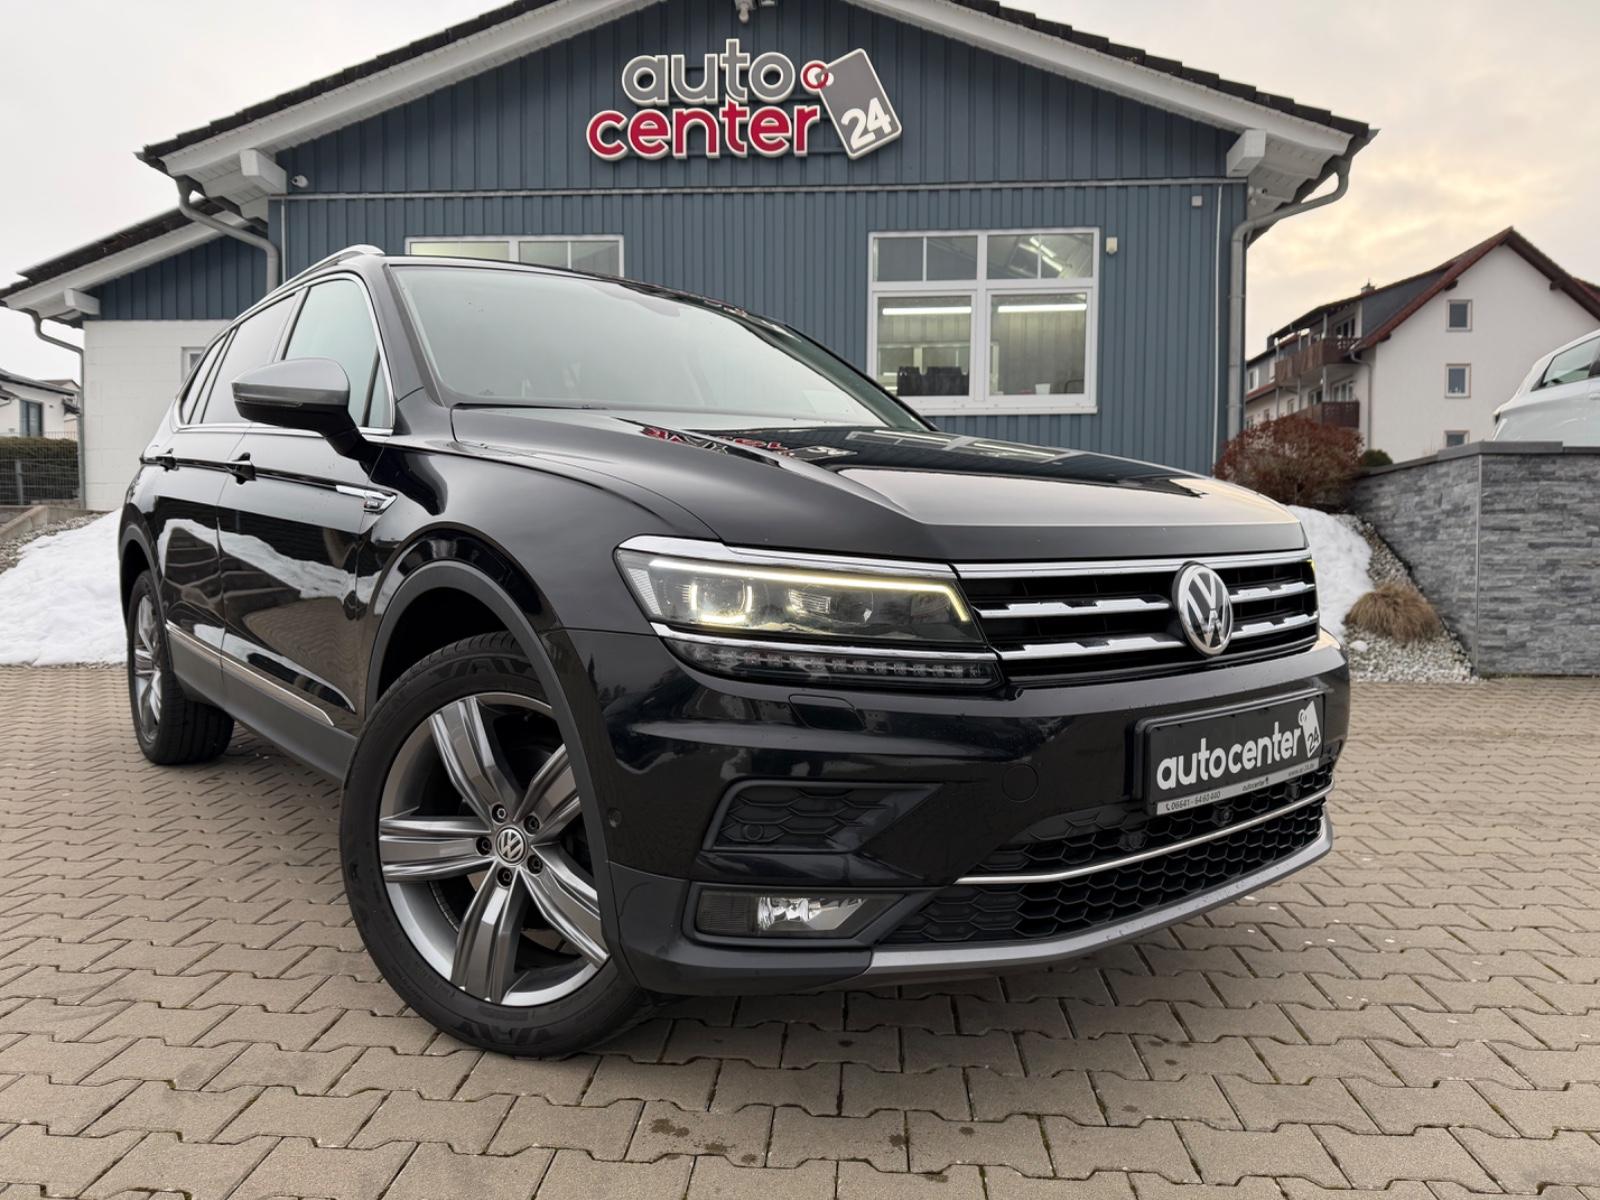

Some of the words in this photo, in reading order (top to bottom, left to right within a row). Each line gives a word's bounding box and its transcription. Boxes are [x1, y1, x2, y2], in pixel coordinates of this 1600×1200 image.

[622, 38, 796, 106] auto
[586, 95, 820, 160] center
[840, 96, 892, 150] 24
[1156, 721, 1302, 790] autocenter
[1307, 725, 1320, 754] 24
